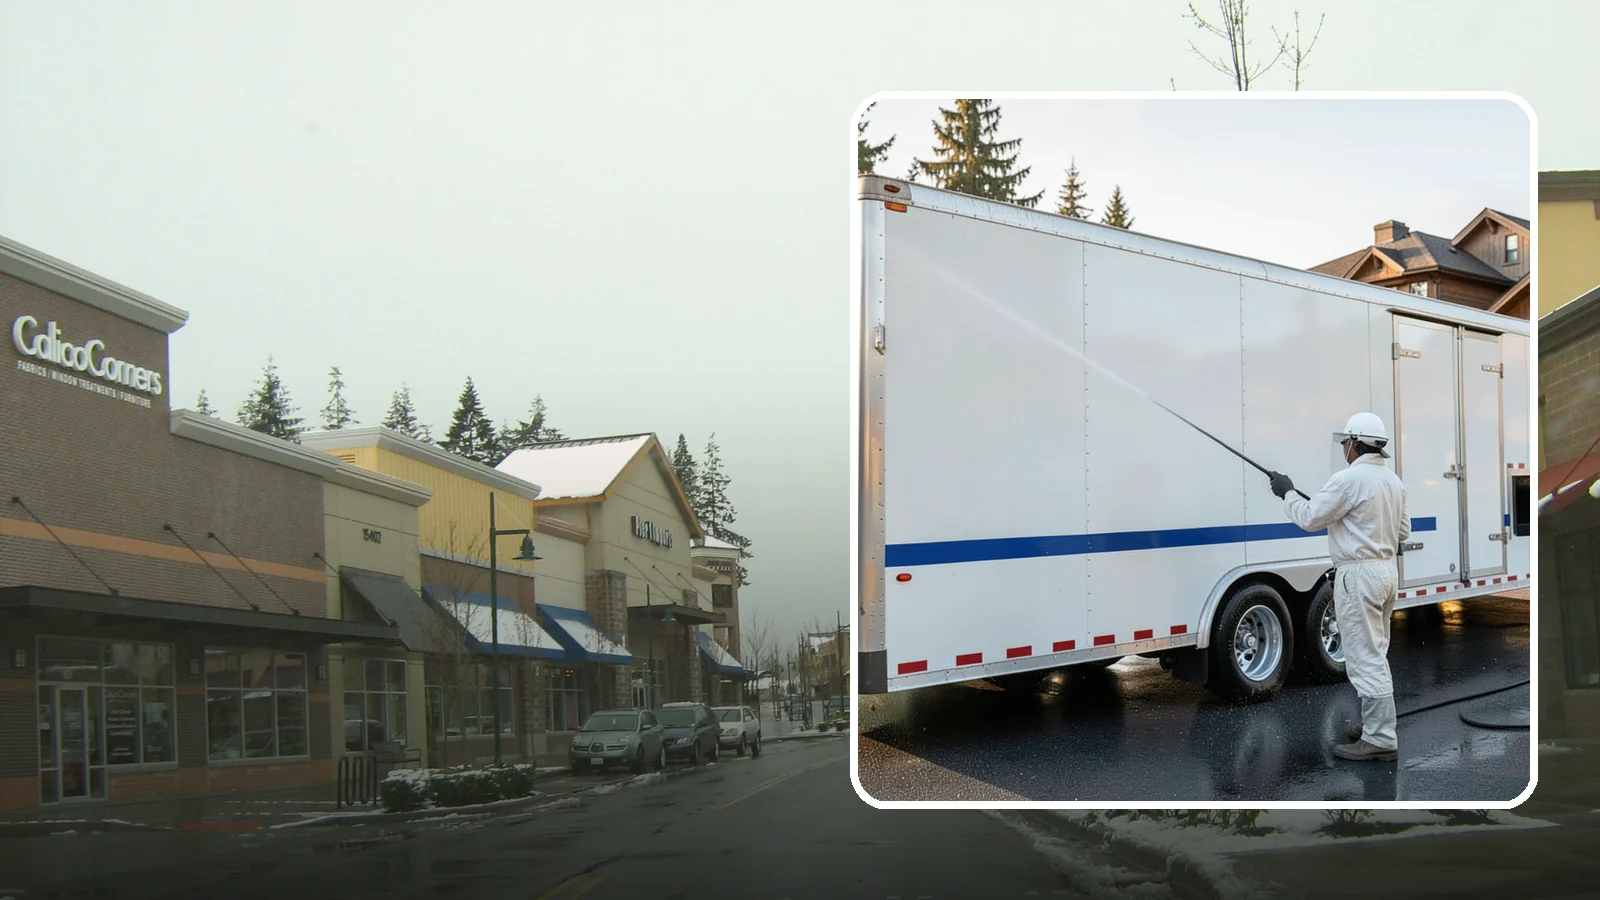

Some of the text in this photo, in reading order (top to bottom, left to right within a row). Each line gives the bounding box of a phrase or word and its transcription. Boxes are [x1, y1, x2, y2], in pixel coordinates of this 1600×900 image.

[17, 359, 151, 408] FABRICS WINDOW TREATMENTS FURNITURE
